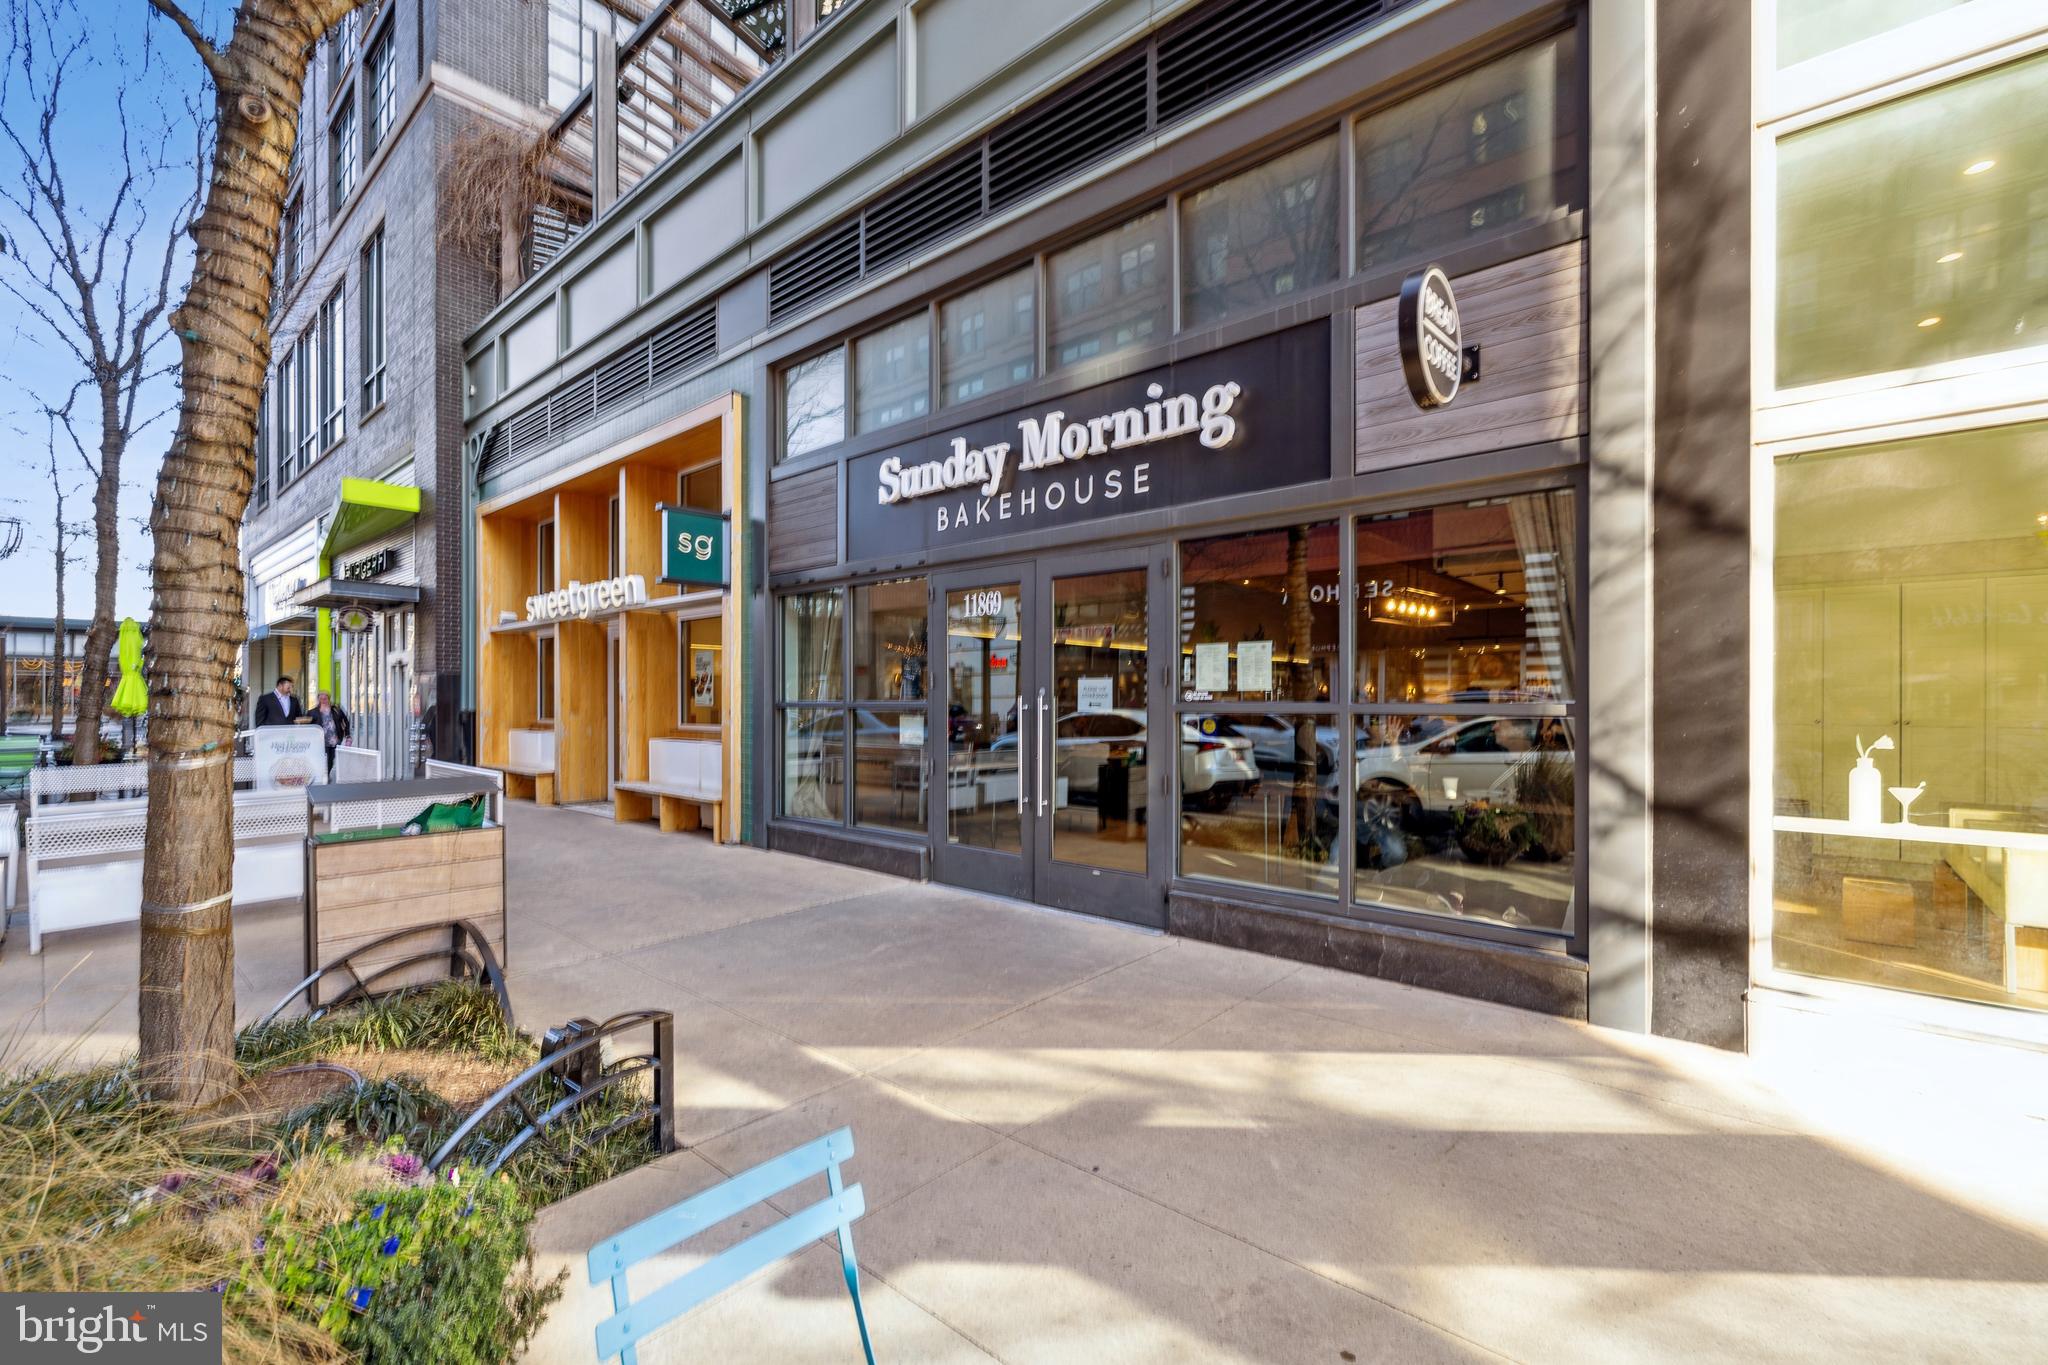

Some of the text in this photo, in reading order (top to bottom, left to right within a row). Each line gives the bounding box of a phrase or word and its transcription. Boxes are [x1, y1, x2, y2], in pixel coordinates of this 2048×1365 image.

[1425, 286, 1457, 335] BREAD
[1424, 333, 1458, 381] COFFEE
[878, 381, 1241, 505] Sunday Morning
[937, 462, 1151, 532] BAKEHOUSE
[678, 532, 713, 561] sg
[526, 574, 646, 622] sweetgreen
[963, 590, 1002, 618] 11869
